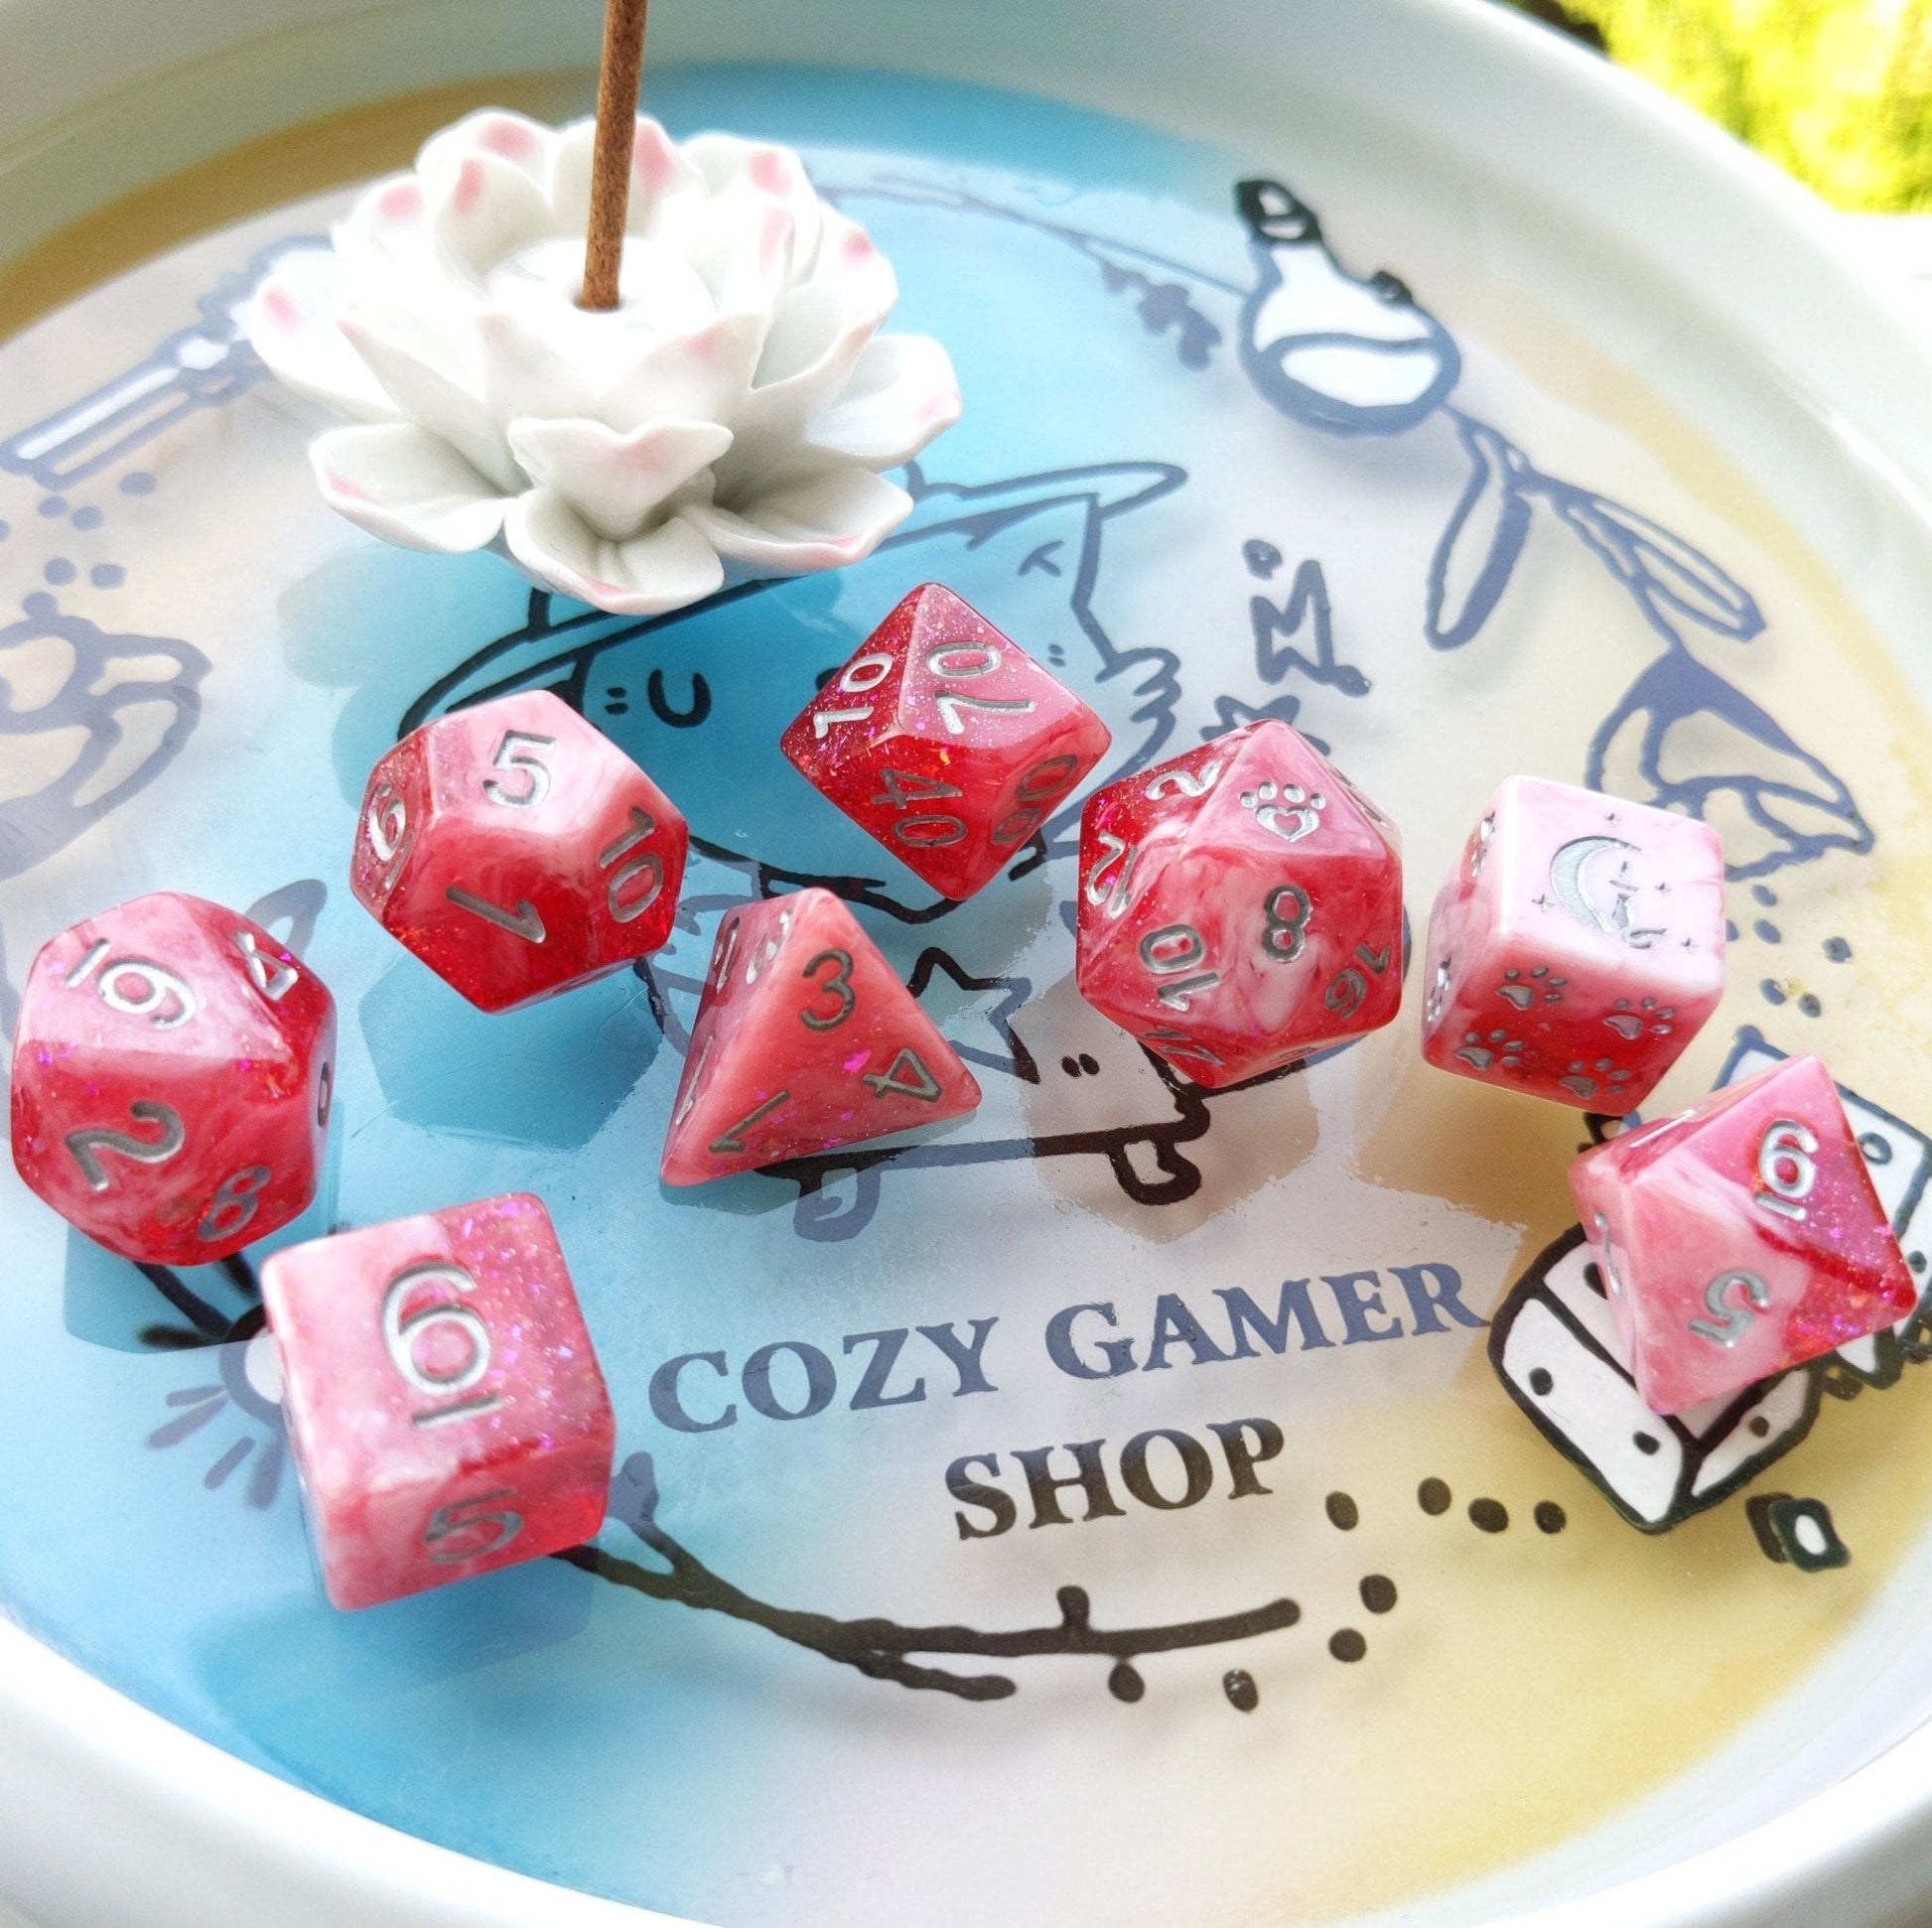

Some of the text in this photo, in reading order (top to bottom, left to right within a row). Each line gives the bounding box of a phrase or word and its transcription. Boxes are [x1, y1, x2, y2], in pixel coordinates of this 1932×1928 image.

[813, 653, 894, 739] 10
[925, 641, 1036, 735] 70
[483, 730, 555, 809] 5
[871, 768, 967, 848] 40
[1145, 759, 1223, 800] 2
[599, 805, 664, 924] 10
[445, 886, 546, 944] 1
[1260, 885, 1312, 963] 8
[801, 949, 857, 1032] 3
[1139, 923, 1221, 1013] 10
[862, 1047, 942, 1103] 4
[65, 1100, 187, 1191] 2
[708, 1090, 790, 1154] 1
[1754, 1119, 1818, 1221] 6
[380, 1260, 503, 1430] 6
[648, 1261, 1492, 1435] COZY GAMER
[1688, 1269, 1770, 1349] 5
[944, 1417, 1285, 1541] SHOP
[424, 1486, 524, 1565] 5
